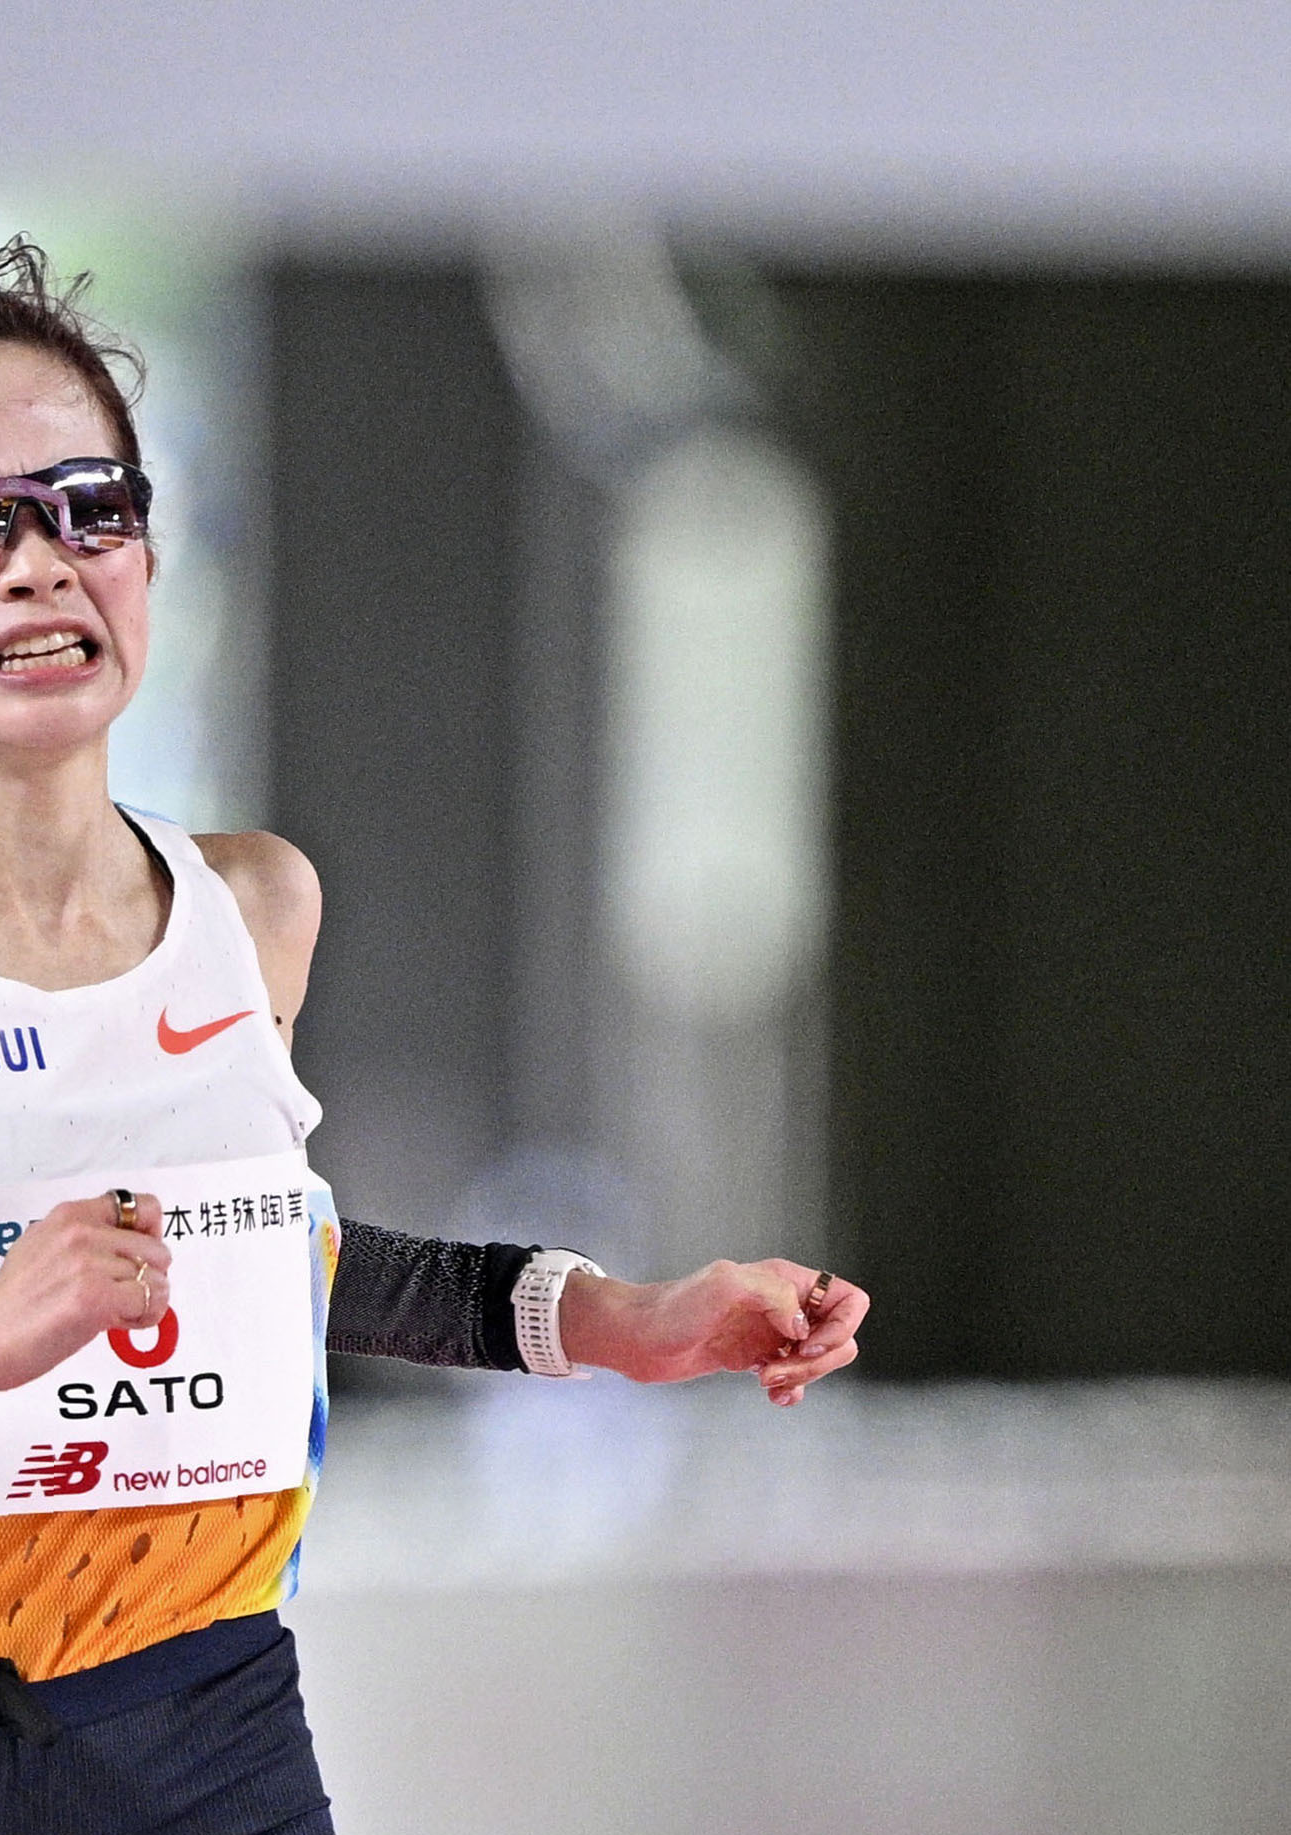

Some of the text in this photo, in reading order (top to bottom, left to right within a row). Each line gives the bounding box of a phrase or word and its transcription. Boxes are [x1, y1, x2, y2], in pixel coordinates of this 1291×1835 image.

[57, 1373, 224, 1420] SATO
[113, 1458, 267, 1491] new balance
